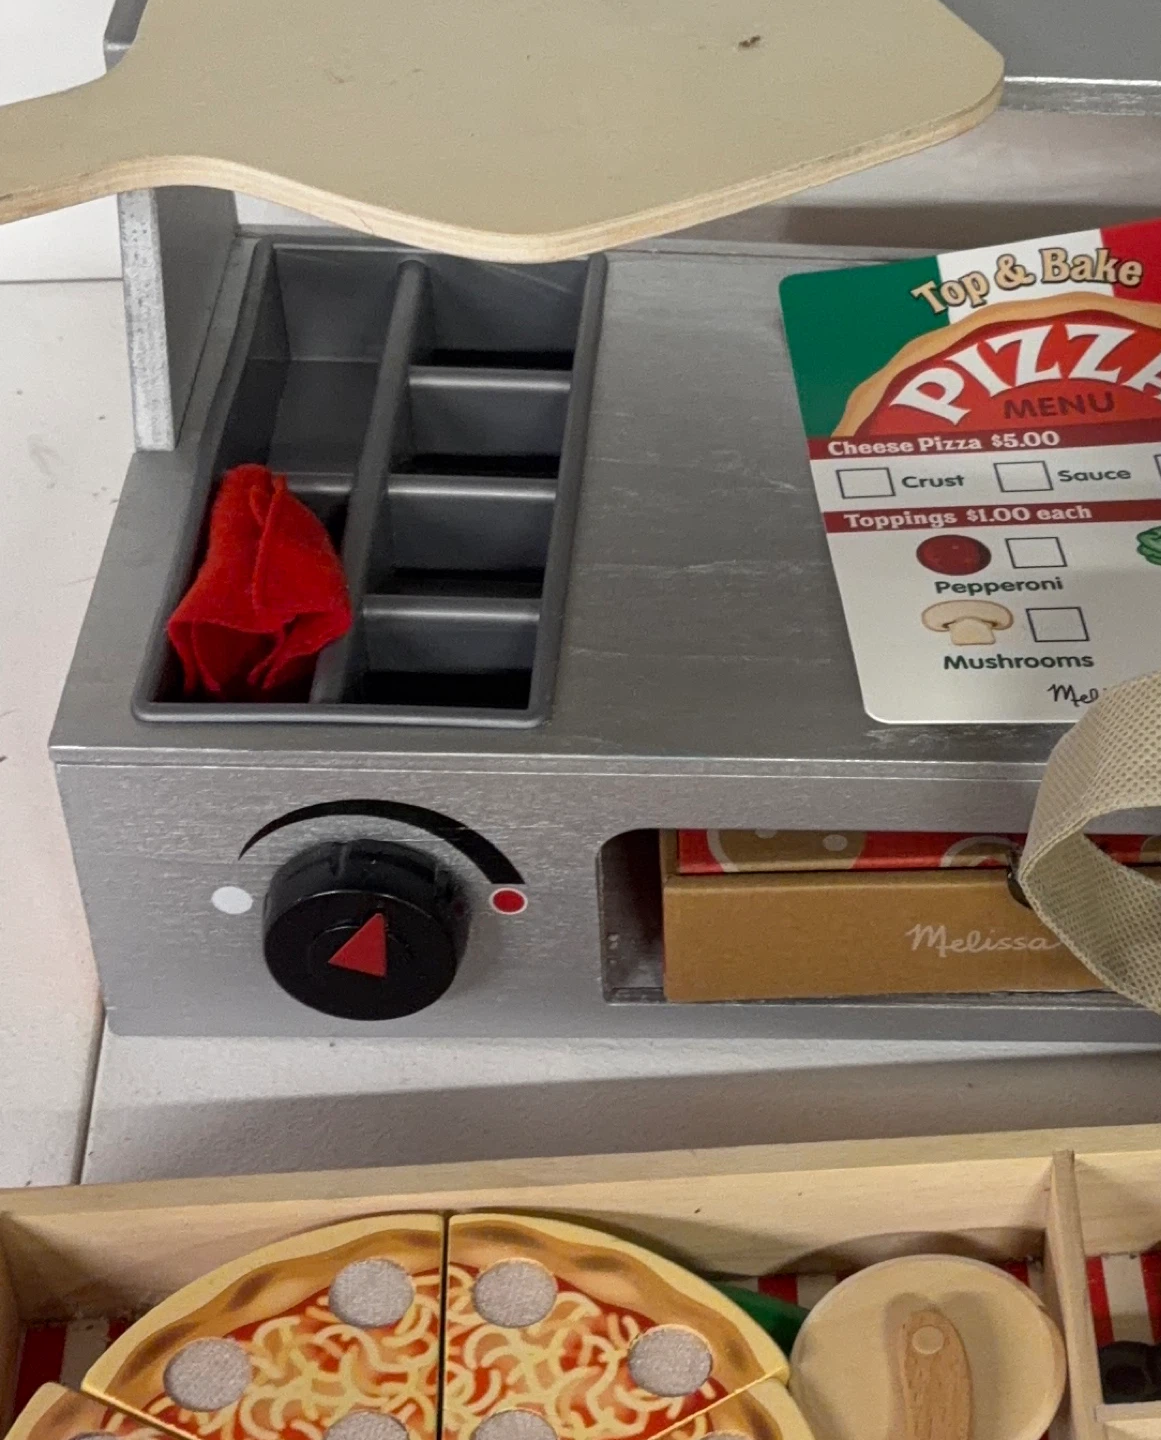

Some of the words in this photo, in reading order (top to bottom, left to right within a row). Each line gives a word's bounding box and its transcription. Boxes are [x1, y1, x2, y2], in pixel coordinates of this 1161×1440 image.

[910, 270, 990, 315] Top
[994, 253, 1036, 291] &
[1038, 246, 1144, 288] Bake
[1002, 391, 1116, 421] MENU
[827, 436, 914, 457] Cheese
[919, 433, 983, 452] Pizza
[991, 430, 1061, 450] $5.00
[901, 473, 966, 490] Crust
[1057, 467, 1132, 483] Sauce
[843, 510, 957, 530] Toppings
[966, 506, 1031, 525] $1.00
[1036, 504, 1093, 522] each
[934, 575, 1064, 594] Pepperoni
[943, 653, 1095, 670] Mushrooms
[904, 923, 1061, 958] Melissa
